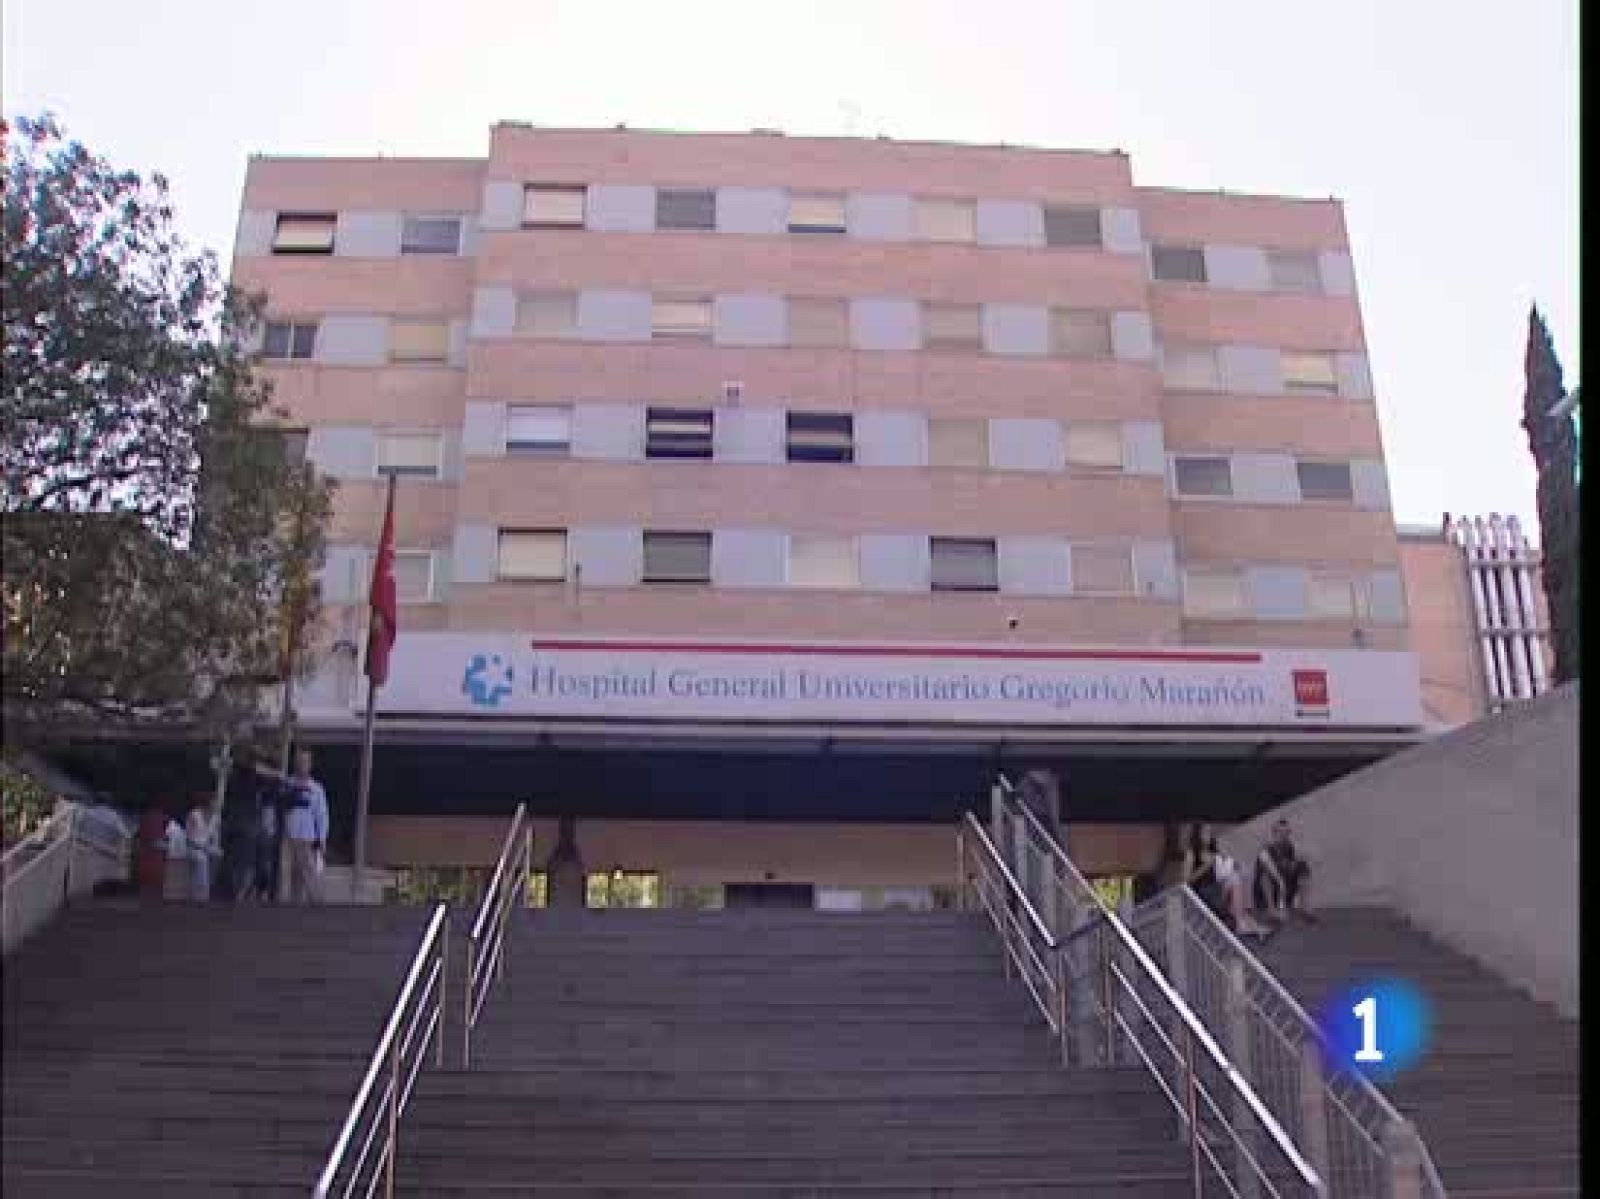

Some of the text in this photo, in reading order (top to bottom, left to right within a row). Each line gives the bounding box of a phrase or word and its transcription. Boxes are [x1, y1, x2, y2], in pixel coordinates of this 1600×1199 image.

[529, 666, 656, 700] Hospital
[667, 666, 785, 699] General
[799, 669, 990, 701] Universitario
[1000, 674, 1130, 708] Gregorio
